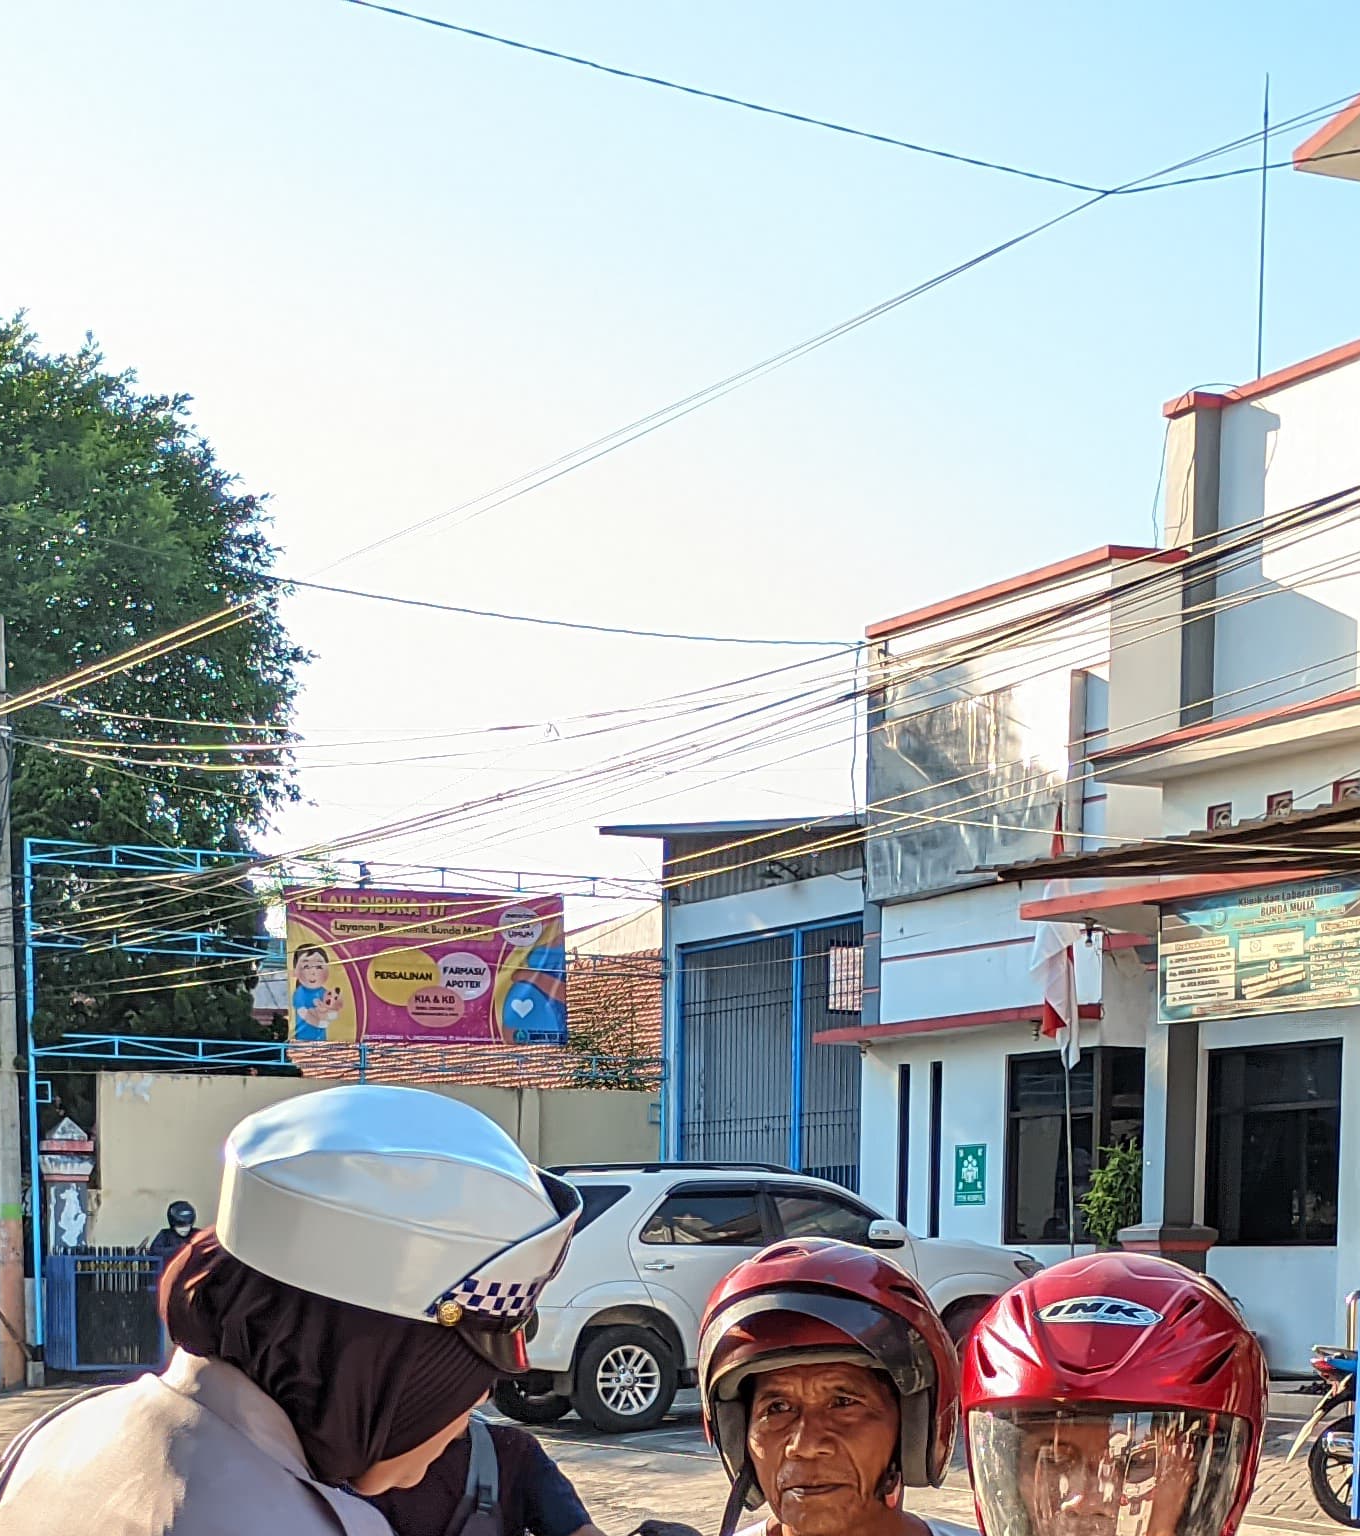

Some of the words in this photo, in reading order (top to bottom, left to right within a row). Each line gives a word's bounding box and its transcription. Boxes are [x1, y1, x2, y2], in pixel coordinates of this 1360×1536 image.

[358, 896, 421, 916] DIBUKA
[1260, 904, 1287, 917] BUNDA
[374, 970, 433, 981] PERSALINAN
[415, 994, 431, 1003] KIA
[1046, 1302, 1149, 1319] INK
